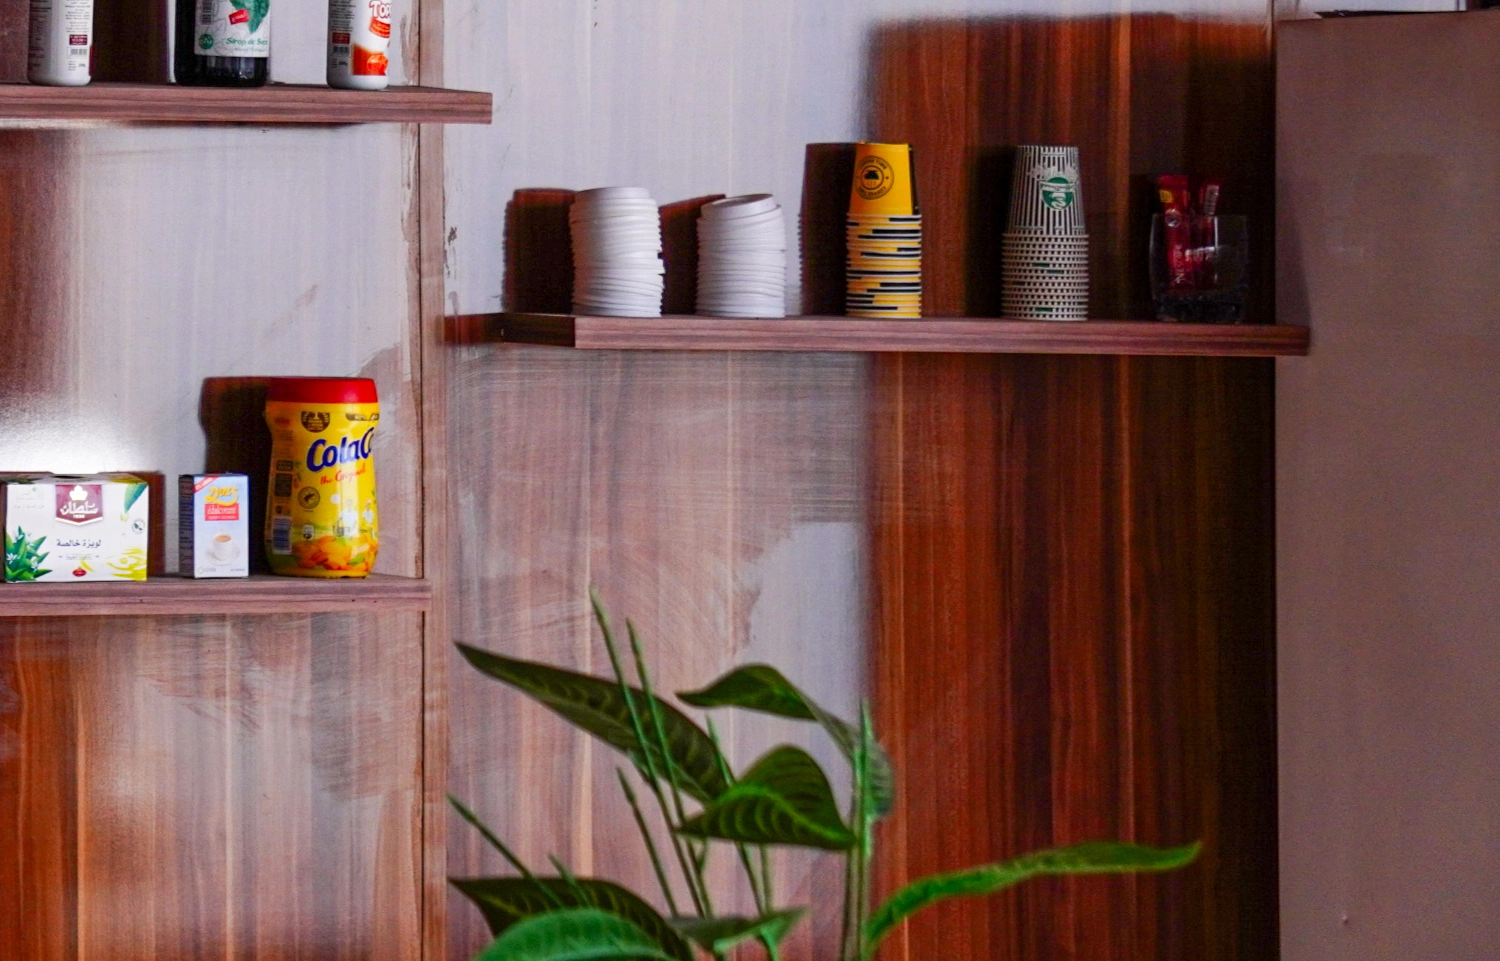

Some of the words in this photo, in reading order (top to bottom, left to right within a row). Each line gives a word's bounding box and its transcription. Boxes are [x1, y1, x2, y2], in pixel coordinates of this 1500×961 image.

[59, 500, 99, 515] سلطان
[56, 538, 81, 547] خالصة
[82, 539, 102, 549] لويزة
